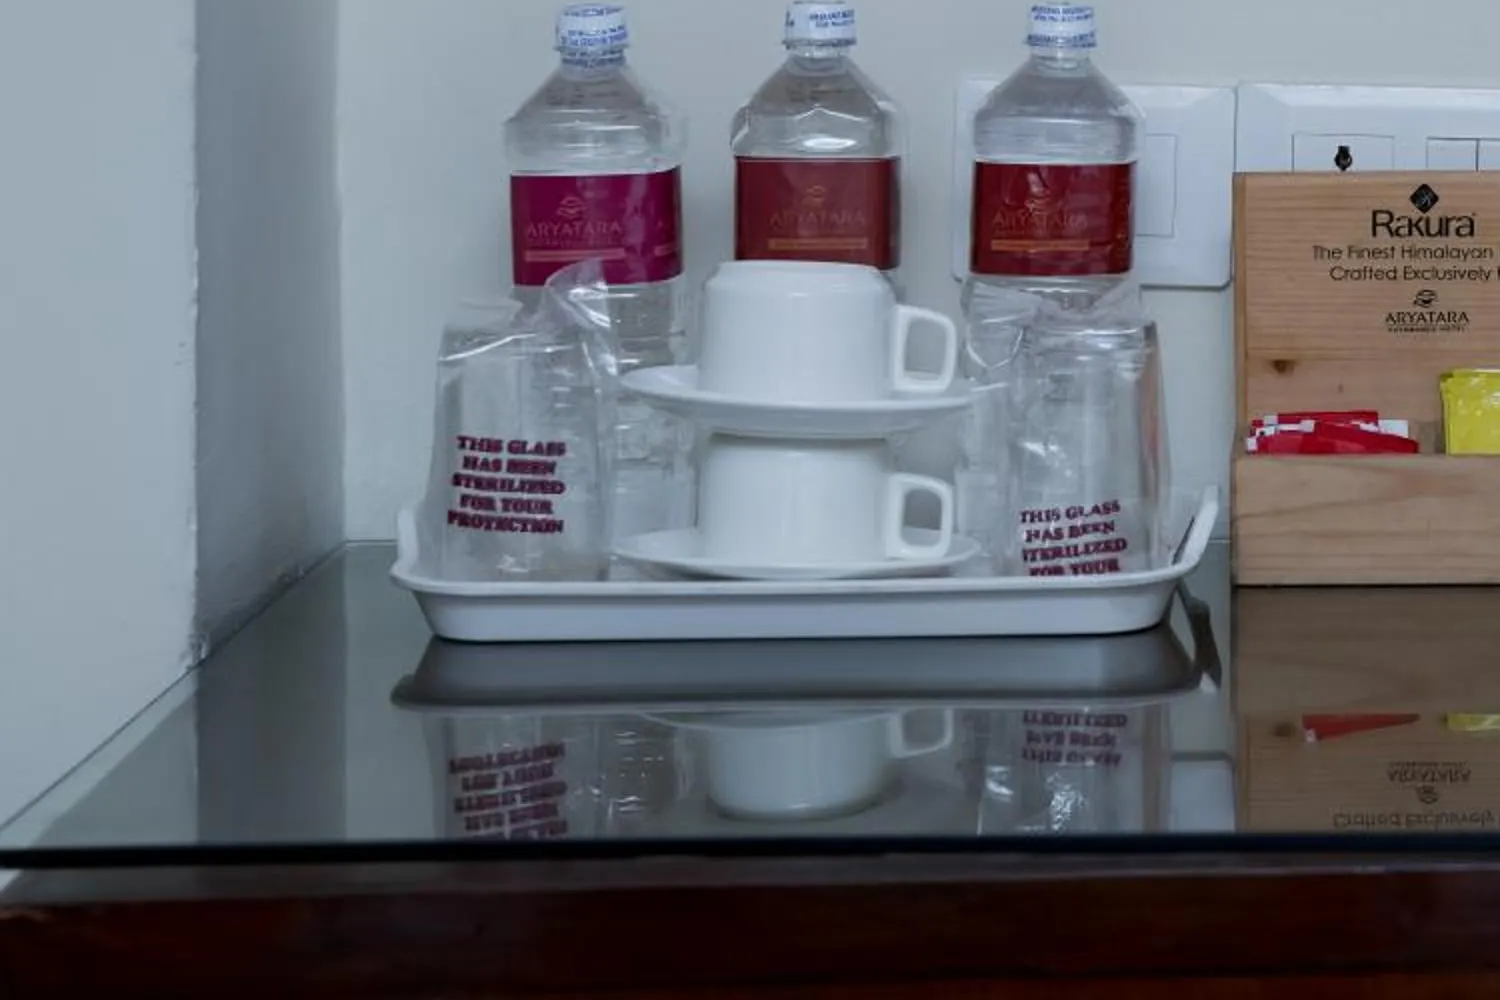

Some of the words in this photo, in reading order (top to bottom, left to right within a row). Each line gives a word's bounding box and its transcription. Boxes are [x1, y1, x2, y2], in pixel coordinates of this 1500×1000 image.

[1371, 210, 1475, 238] Rakura
[1312, 245, 1343, 260] The
[1347, 245, 1396, 260] Finest
[1401, 245, 1494, 263] Himalayan
[1329, 265, 1398, 281] Crafted
[1403, 265, 1492, 283] Exclusively
[1385, 310, 1470, 325] ARYATARA
[457, 435, 503, 453] THIS
[507, 439, 567, 456] GLASS
[463, 456, 502, 472] HAS
[506, 459, 557, 475] BEEN
[459, 494, 497, 511] FOR
[501, 498, 553, 514] YOUR
[1020, 508, 1060, 524] THIS
[1065, 499, 1121, 519] GLASS
[447, 509, 564, 534] PROTECTION
[1025, 527, 1064, 542] HAS
[1068, 520, 1115, 538] BEEN
[1029, 564, 1065, 577] FOR
[1069, 558, 1121, 576] YOUR
